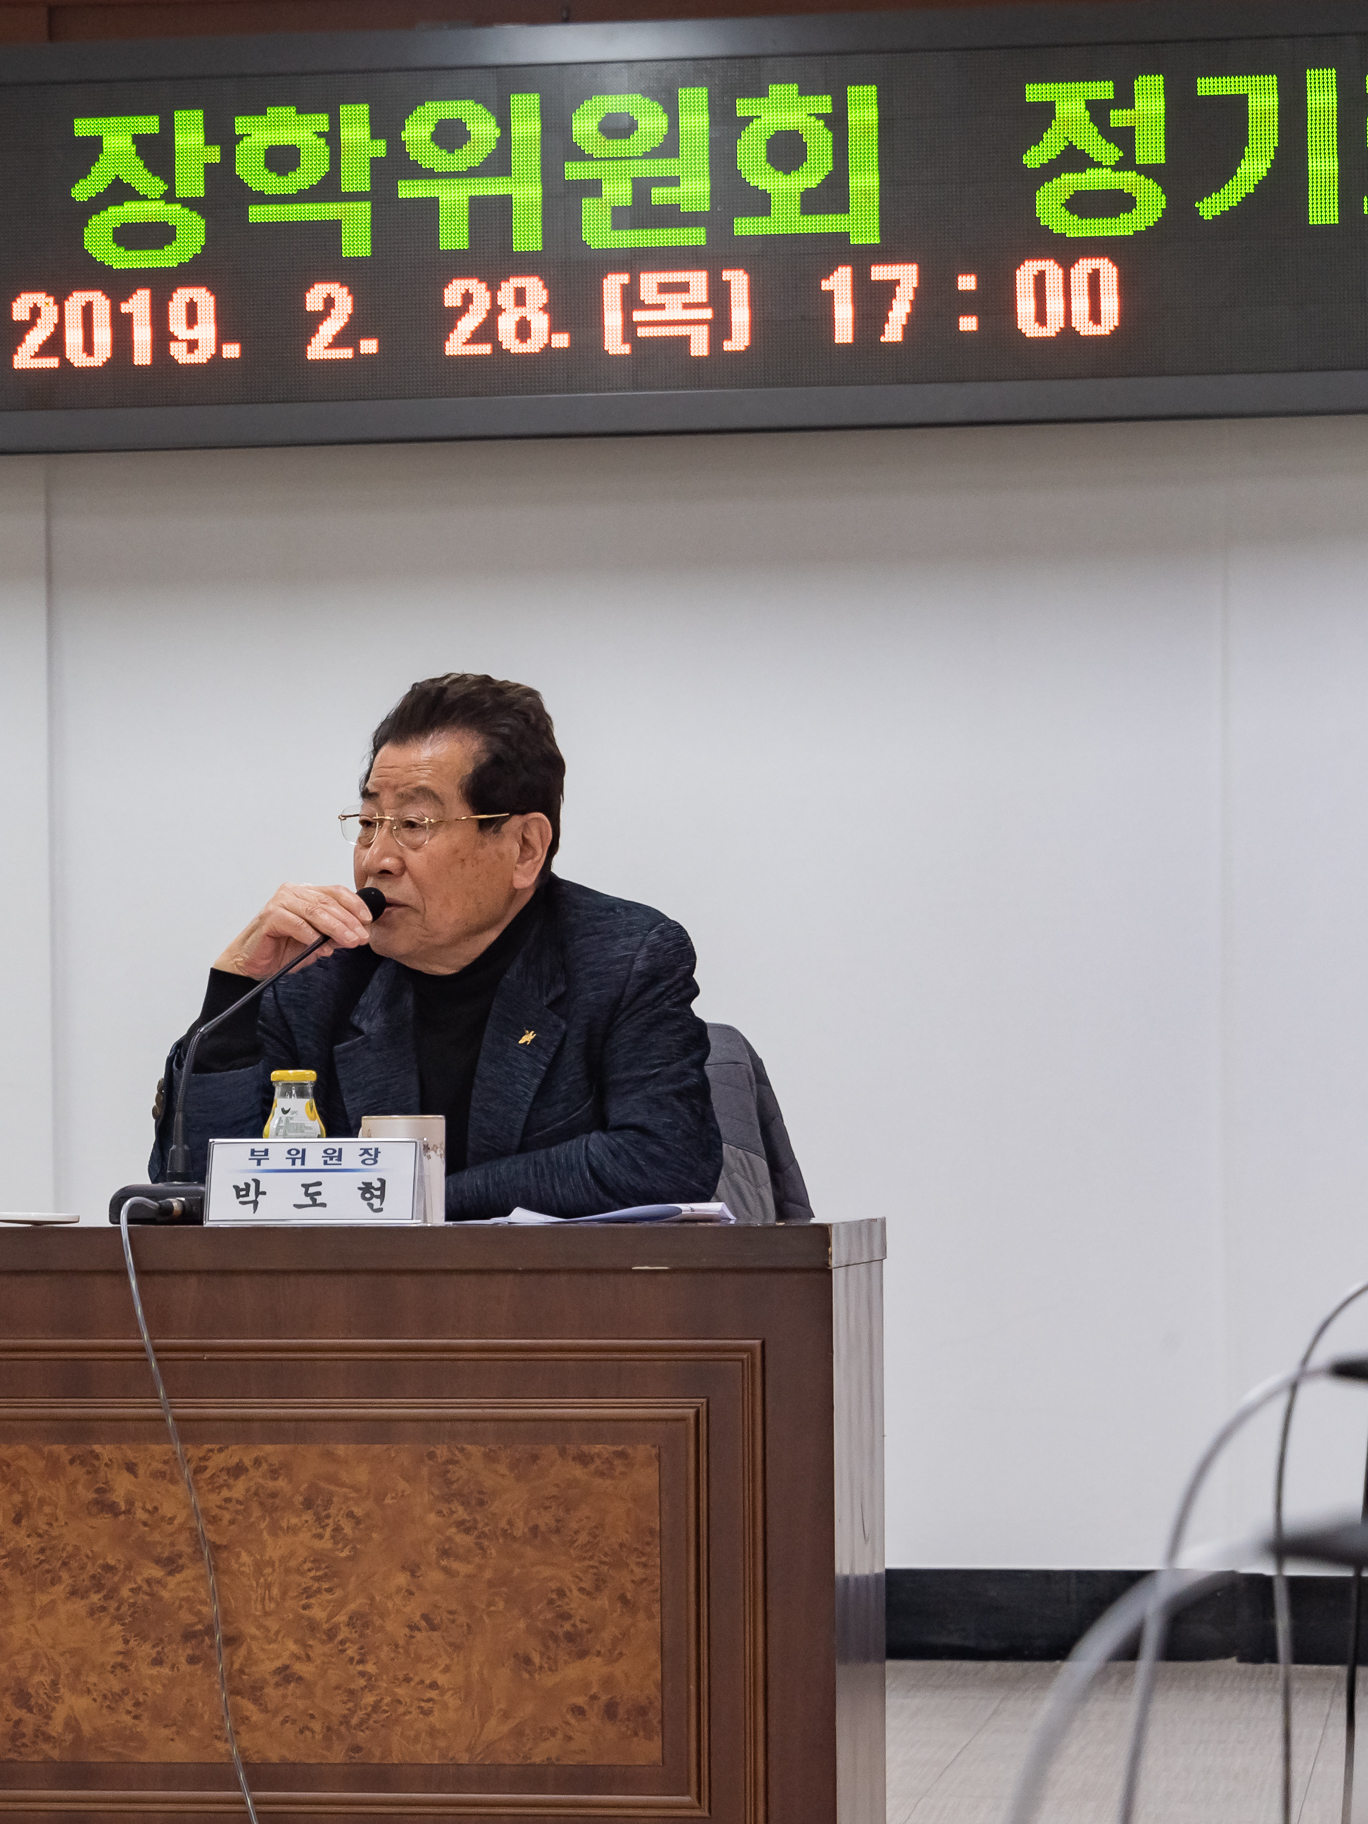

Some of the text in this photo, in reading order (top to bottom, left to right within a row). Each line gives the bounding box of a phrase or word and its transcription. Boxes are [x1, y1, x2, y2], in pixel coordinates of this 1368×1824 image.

[71, 83, 881, 270] 장학위원회
[1023, 67, 1368, 238] 정기
[11, 286, 242, 370] 2019.
[305, 281, 379, 361] 2.
[443, 275, 571, 357] 28.
